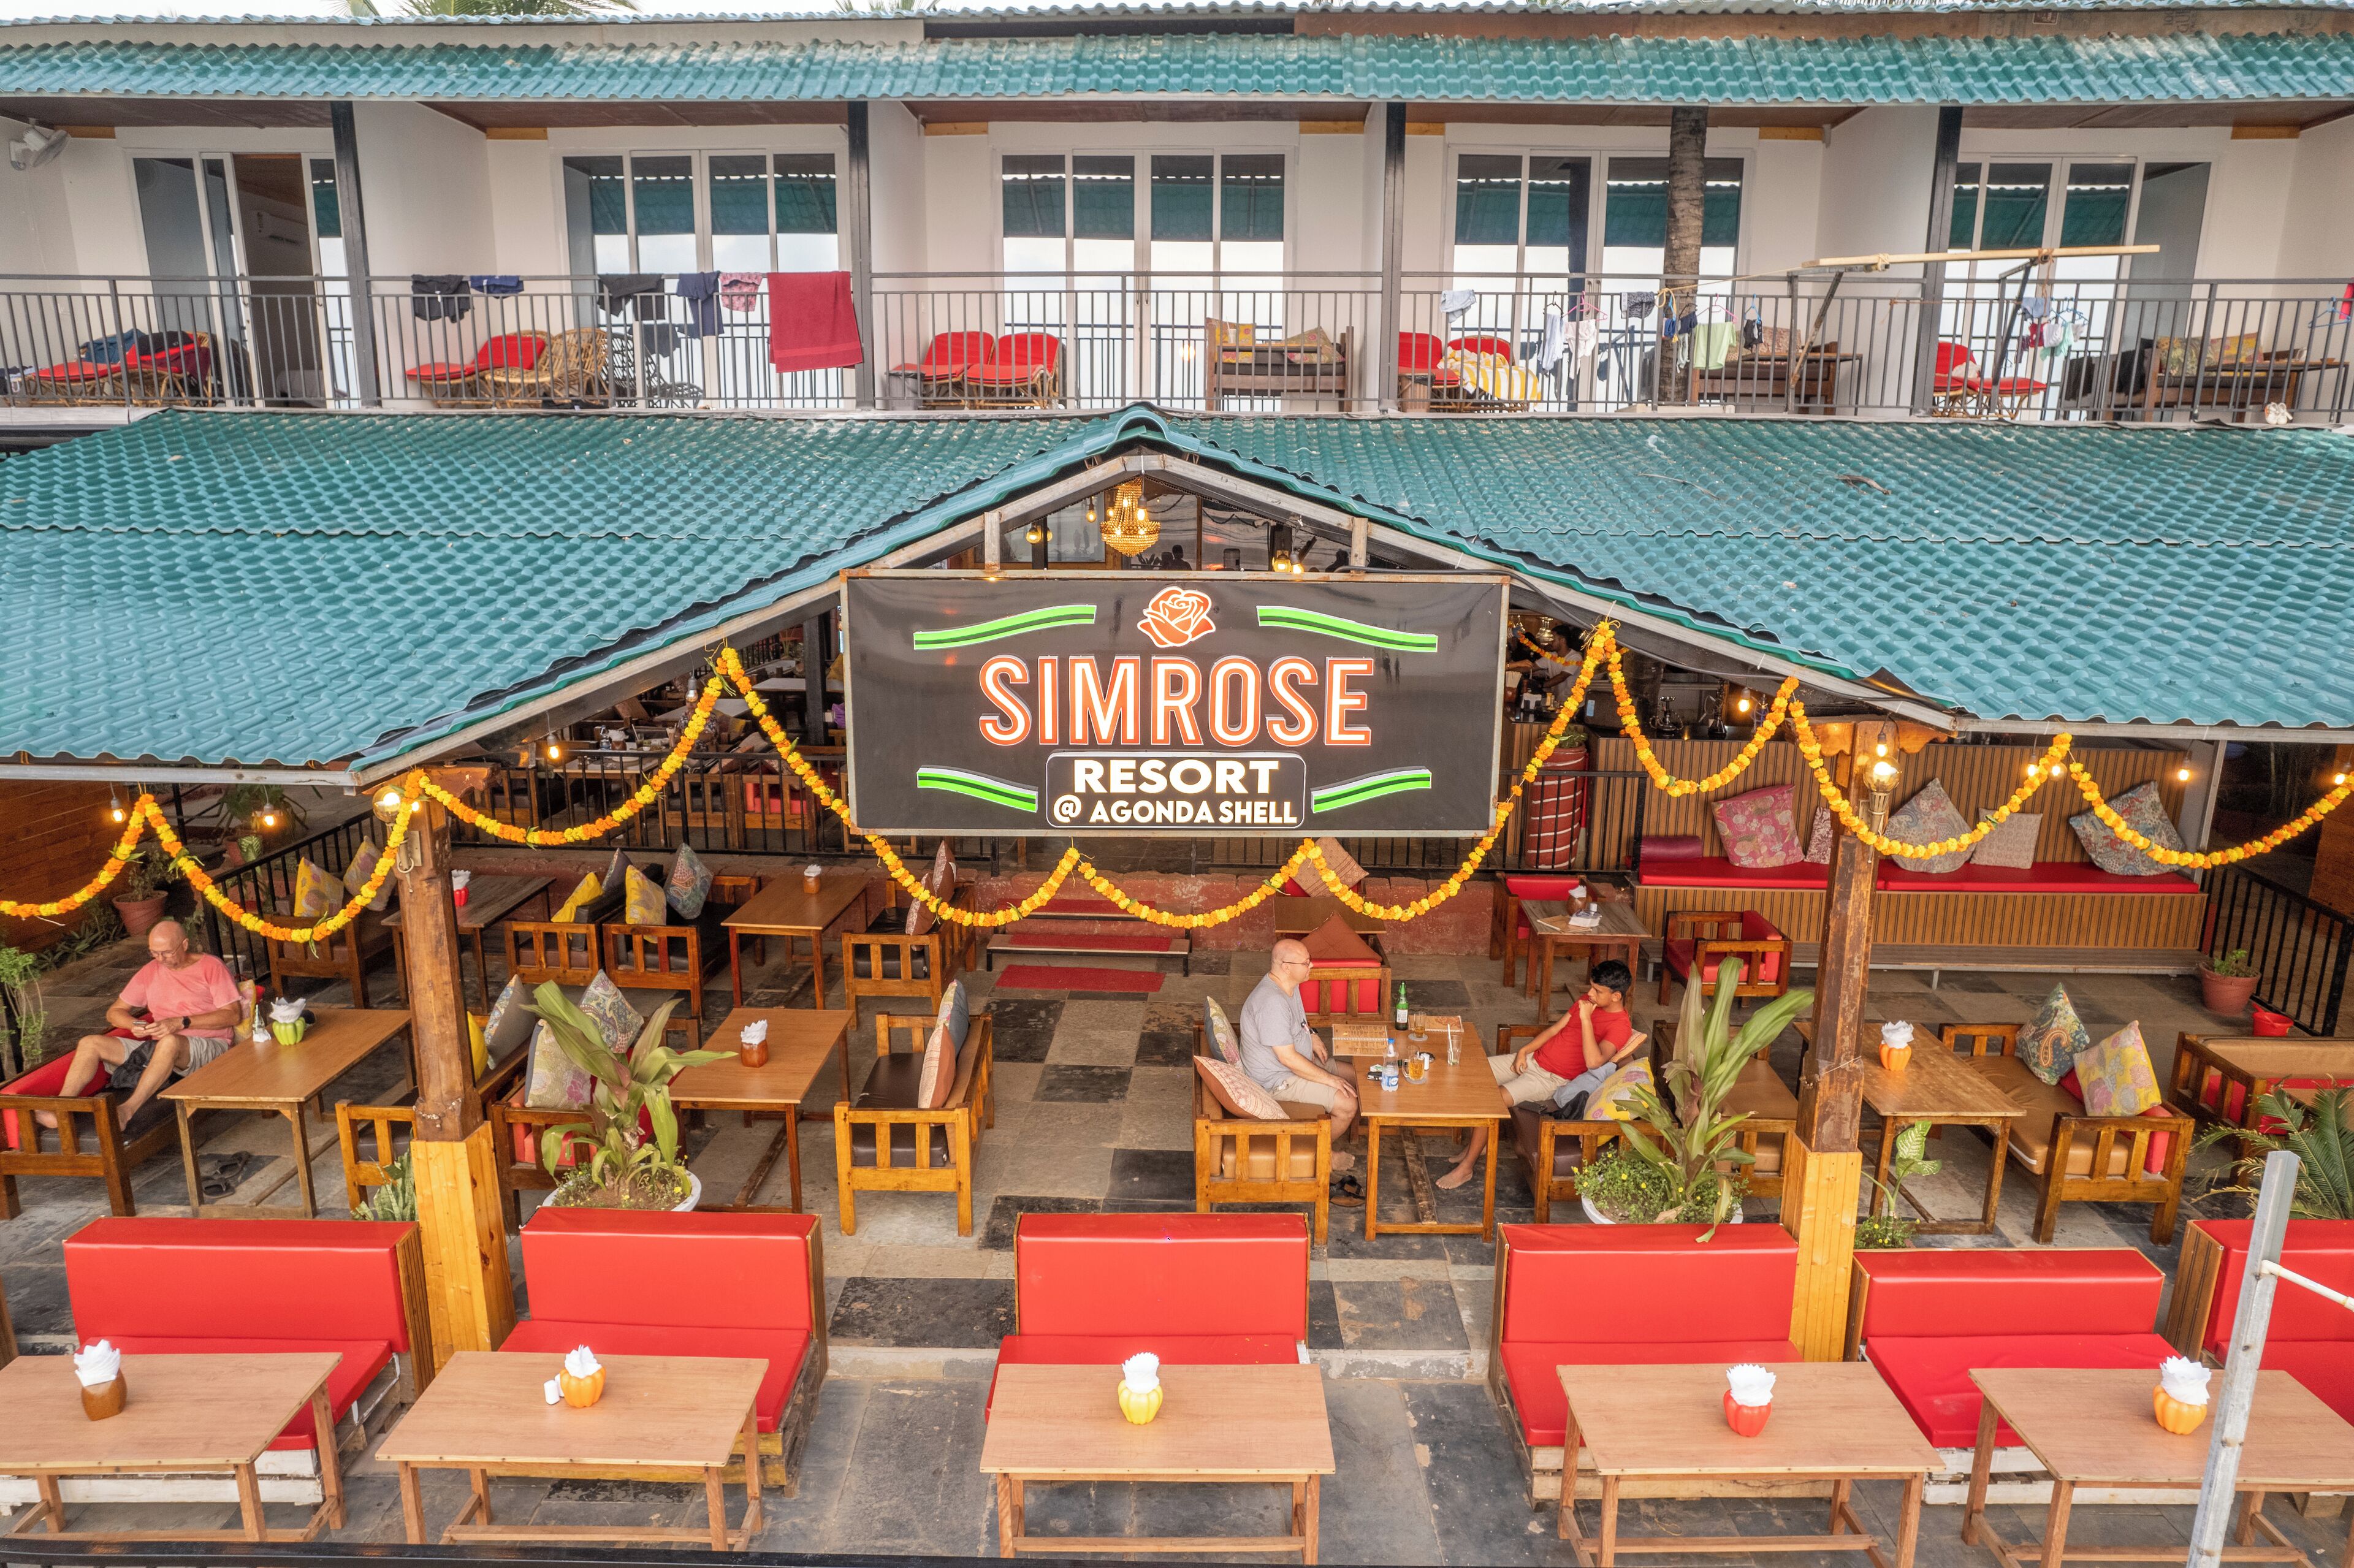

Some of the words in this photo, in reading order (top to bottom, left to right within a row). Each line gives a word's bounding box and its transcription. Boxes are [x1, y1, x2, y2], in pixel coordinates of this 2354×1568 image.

[979, 655, 1374, 747] SIMROSE
[1073, 759, 1279, 794] RESORT
[1053, 794, 1082, 823] @
[1089, 799, 1214, 824] AGONDA
[1218, 800, 1298, 824] SHELL
